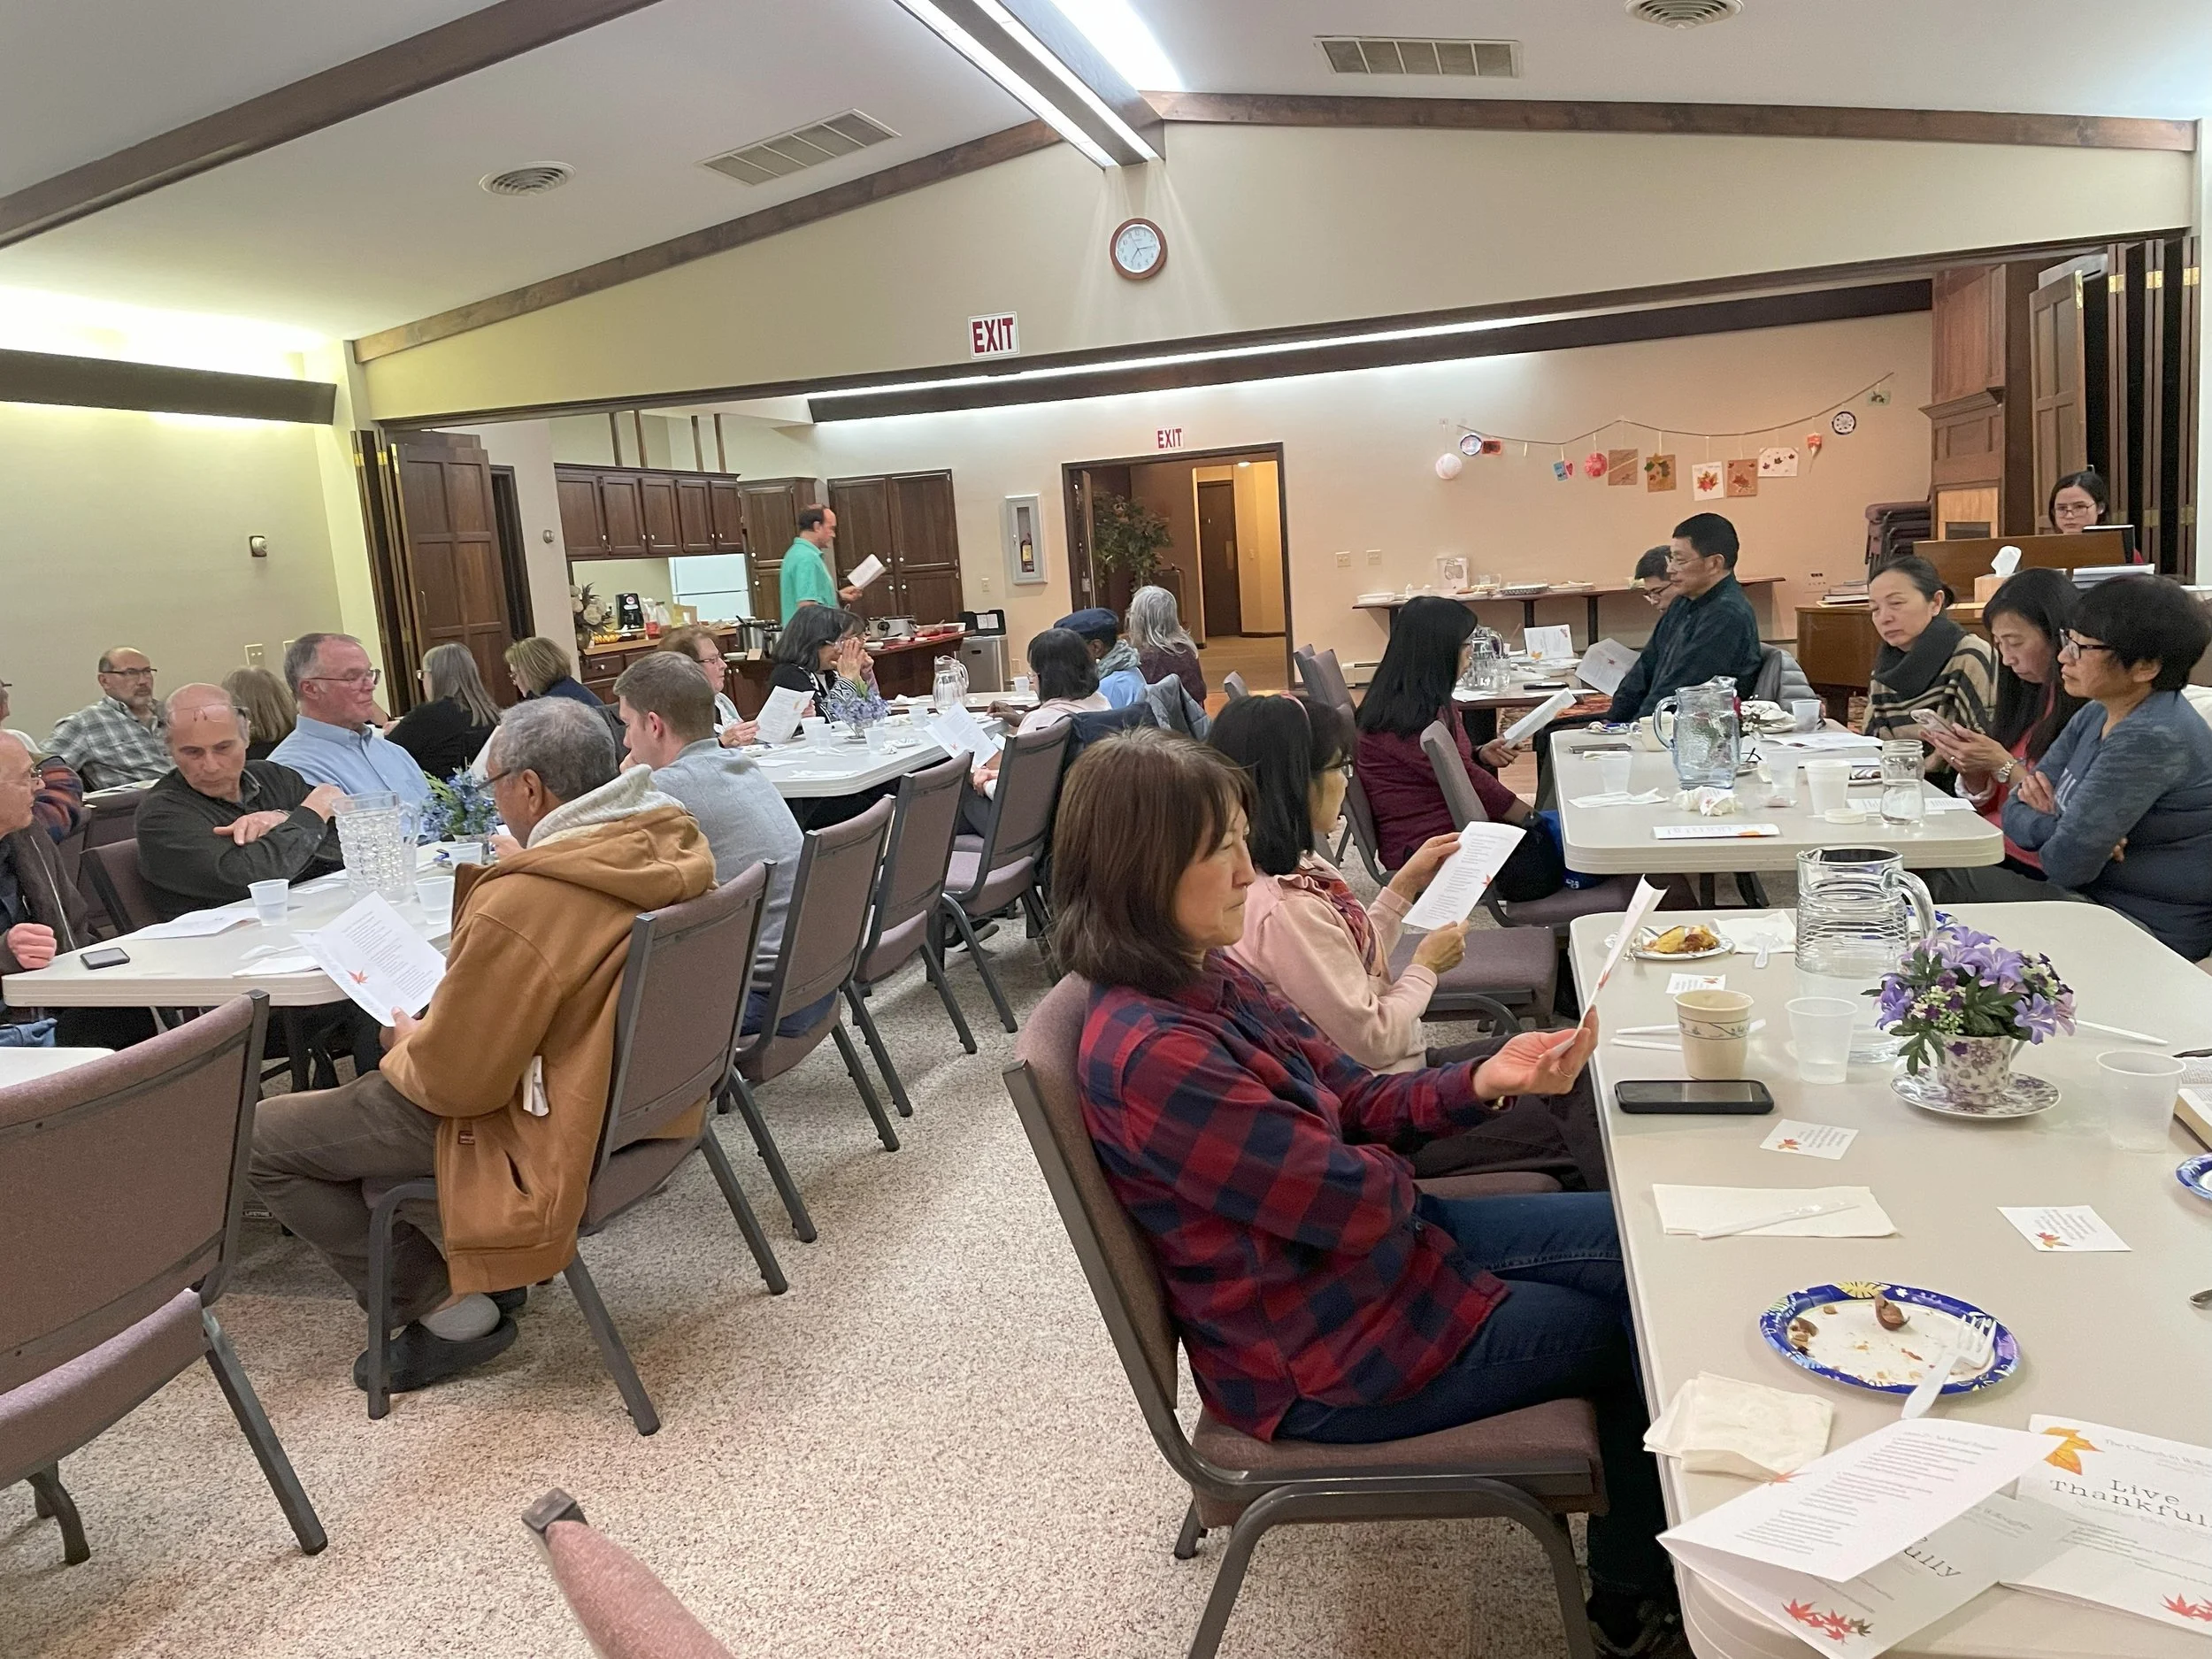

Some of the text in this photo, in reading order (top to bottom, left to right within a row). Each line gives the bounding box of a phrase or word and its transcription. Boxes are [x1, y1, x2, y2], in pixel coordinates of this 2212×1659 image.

[972, 317, 1014, 353] EXIT
[1157, 427, 1182, 449] EXIT
[2049, 1479, 2212, 1528] Thankful
[2110, 1479, 2180, 1504] Live
[1903, 1546, 1962, 1578] ully
